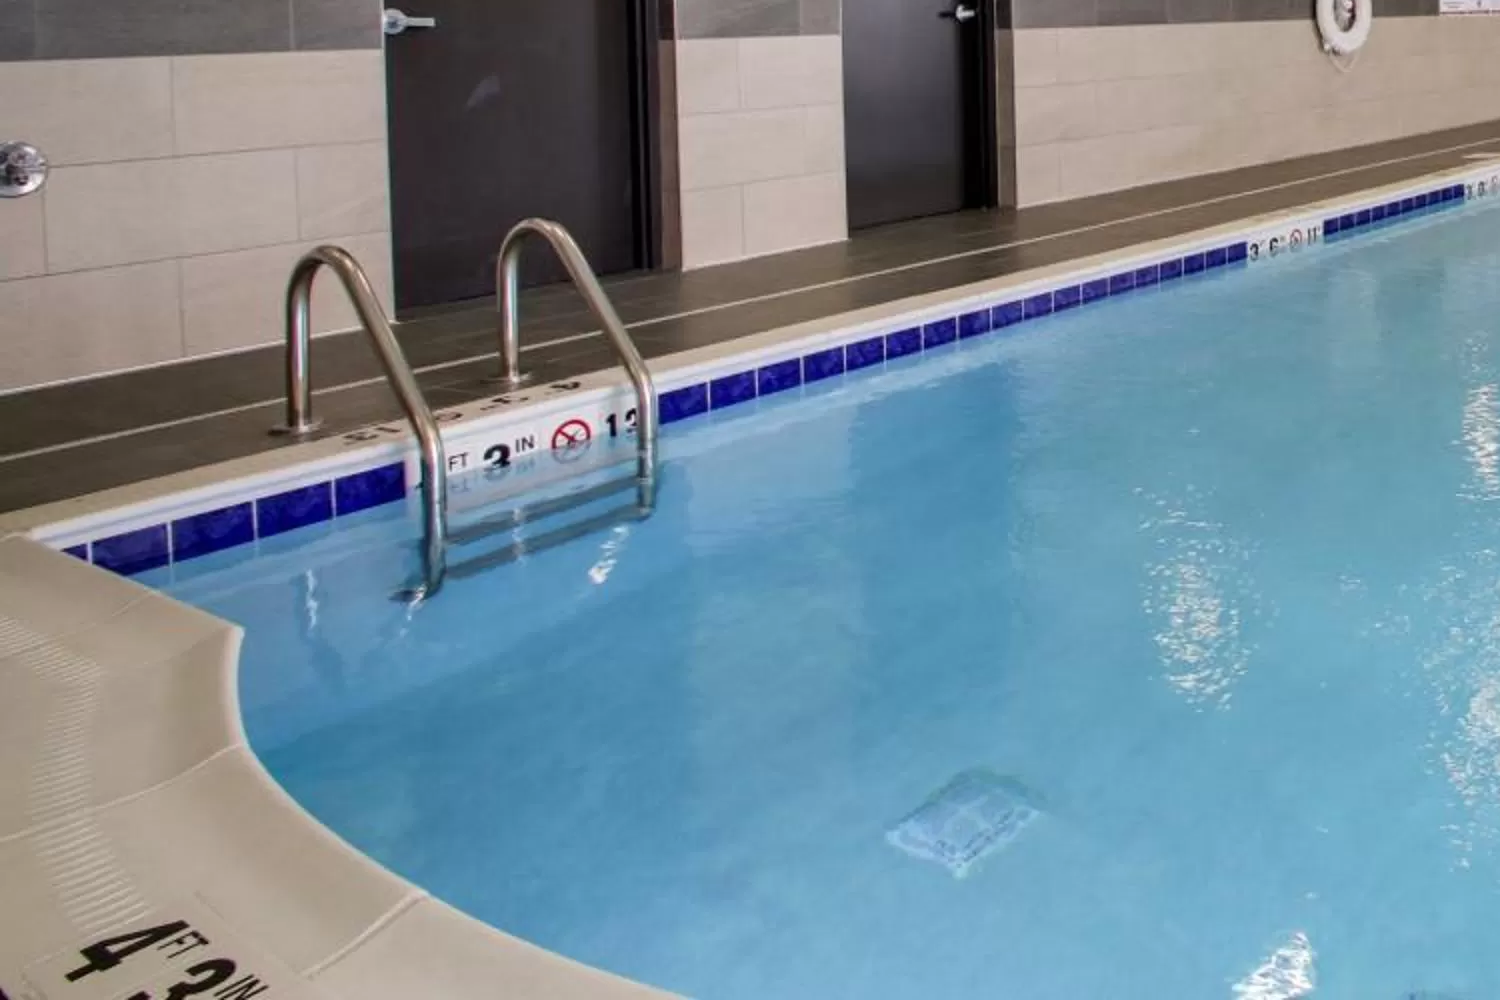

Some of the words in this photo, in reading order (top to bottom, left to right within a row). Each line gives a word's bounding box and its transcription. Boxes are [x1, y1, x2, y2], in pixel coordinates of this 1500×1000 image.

[449, 452, 469, 472] FT
[515, 436, 536, 453] IN
[64, 919, 190, 983] 4
[156, 930, 209, 960] FT
